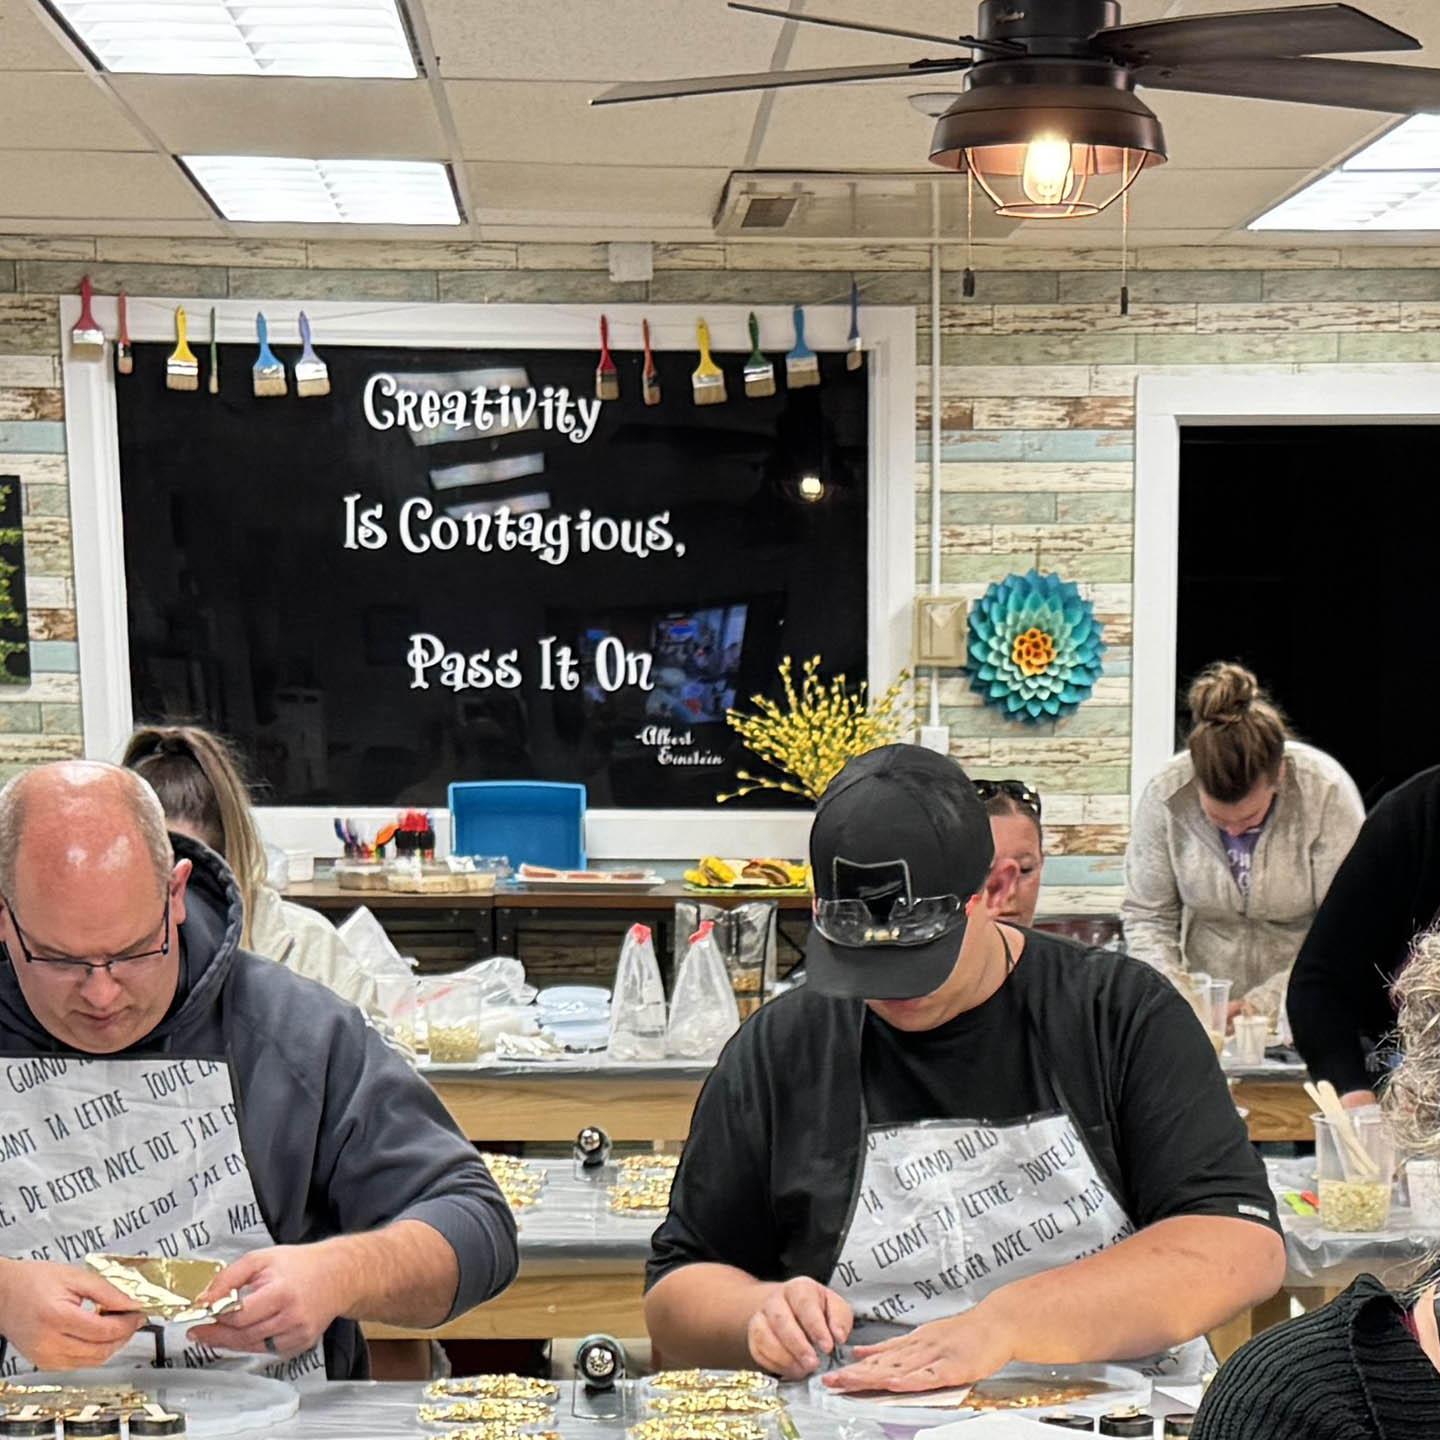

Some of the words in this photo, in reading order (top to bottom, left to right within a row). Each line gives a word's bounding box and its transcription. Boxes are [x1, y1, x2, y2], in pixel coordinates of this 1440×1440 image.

[363, 372, 602, 443] Creativity
[343, 493, 389, 550] Is
[400, 496, 686, 565] Contagious,
[407, 633, 522, 692] Pass
[538, 635, 579, 692] It
[595, 637, 655, 692] On
[657, 745, 726, 766] Einstein
[44, 1114, 71, 1141] TA
[73, 1089, 129, 1131] LETTRE
[142, 1061, 195, 1100] TOUTE
[19, 1185, 47, 1214] DE
[47, 1166, 102, 1205] RESTER
[104, 1146, 145, 1186] AVEC
[144, 1131, 179, 1163] TOI
[181, 1112, 222, 1149] J'AI
[957, 1136, 981, 1162] TU
[55, 1225, 107, 1263] VIVRE
[112, 1206, 150, 1240] AVEC
[149, 1191, 179, 1218] TOI
[188, 1164, 222, 1198] J'AI
[837, 1261, 863, 1288] DE
[871, 1222, 930, 1270] LISANT
[935, 1209, 957, 1233] TA
[961, 1179, 1014, 1219] LETTRE
[1018, 1146, 1065, 1185] TOUTE
[859, 1189, 884, 1215] TA
[157, 1237, 179, 1259] TU
[185, 1220, 211, 1251] RIS
[914, 1279, 941, 1300] DE
[940, 1252, 992, 1292] RESTER
[993, 1237, 1032, 1268] AVEC
[1030, 1215, 1063, 1243] TOI
